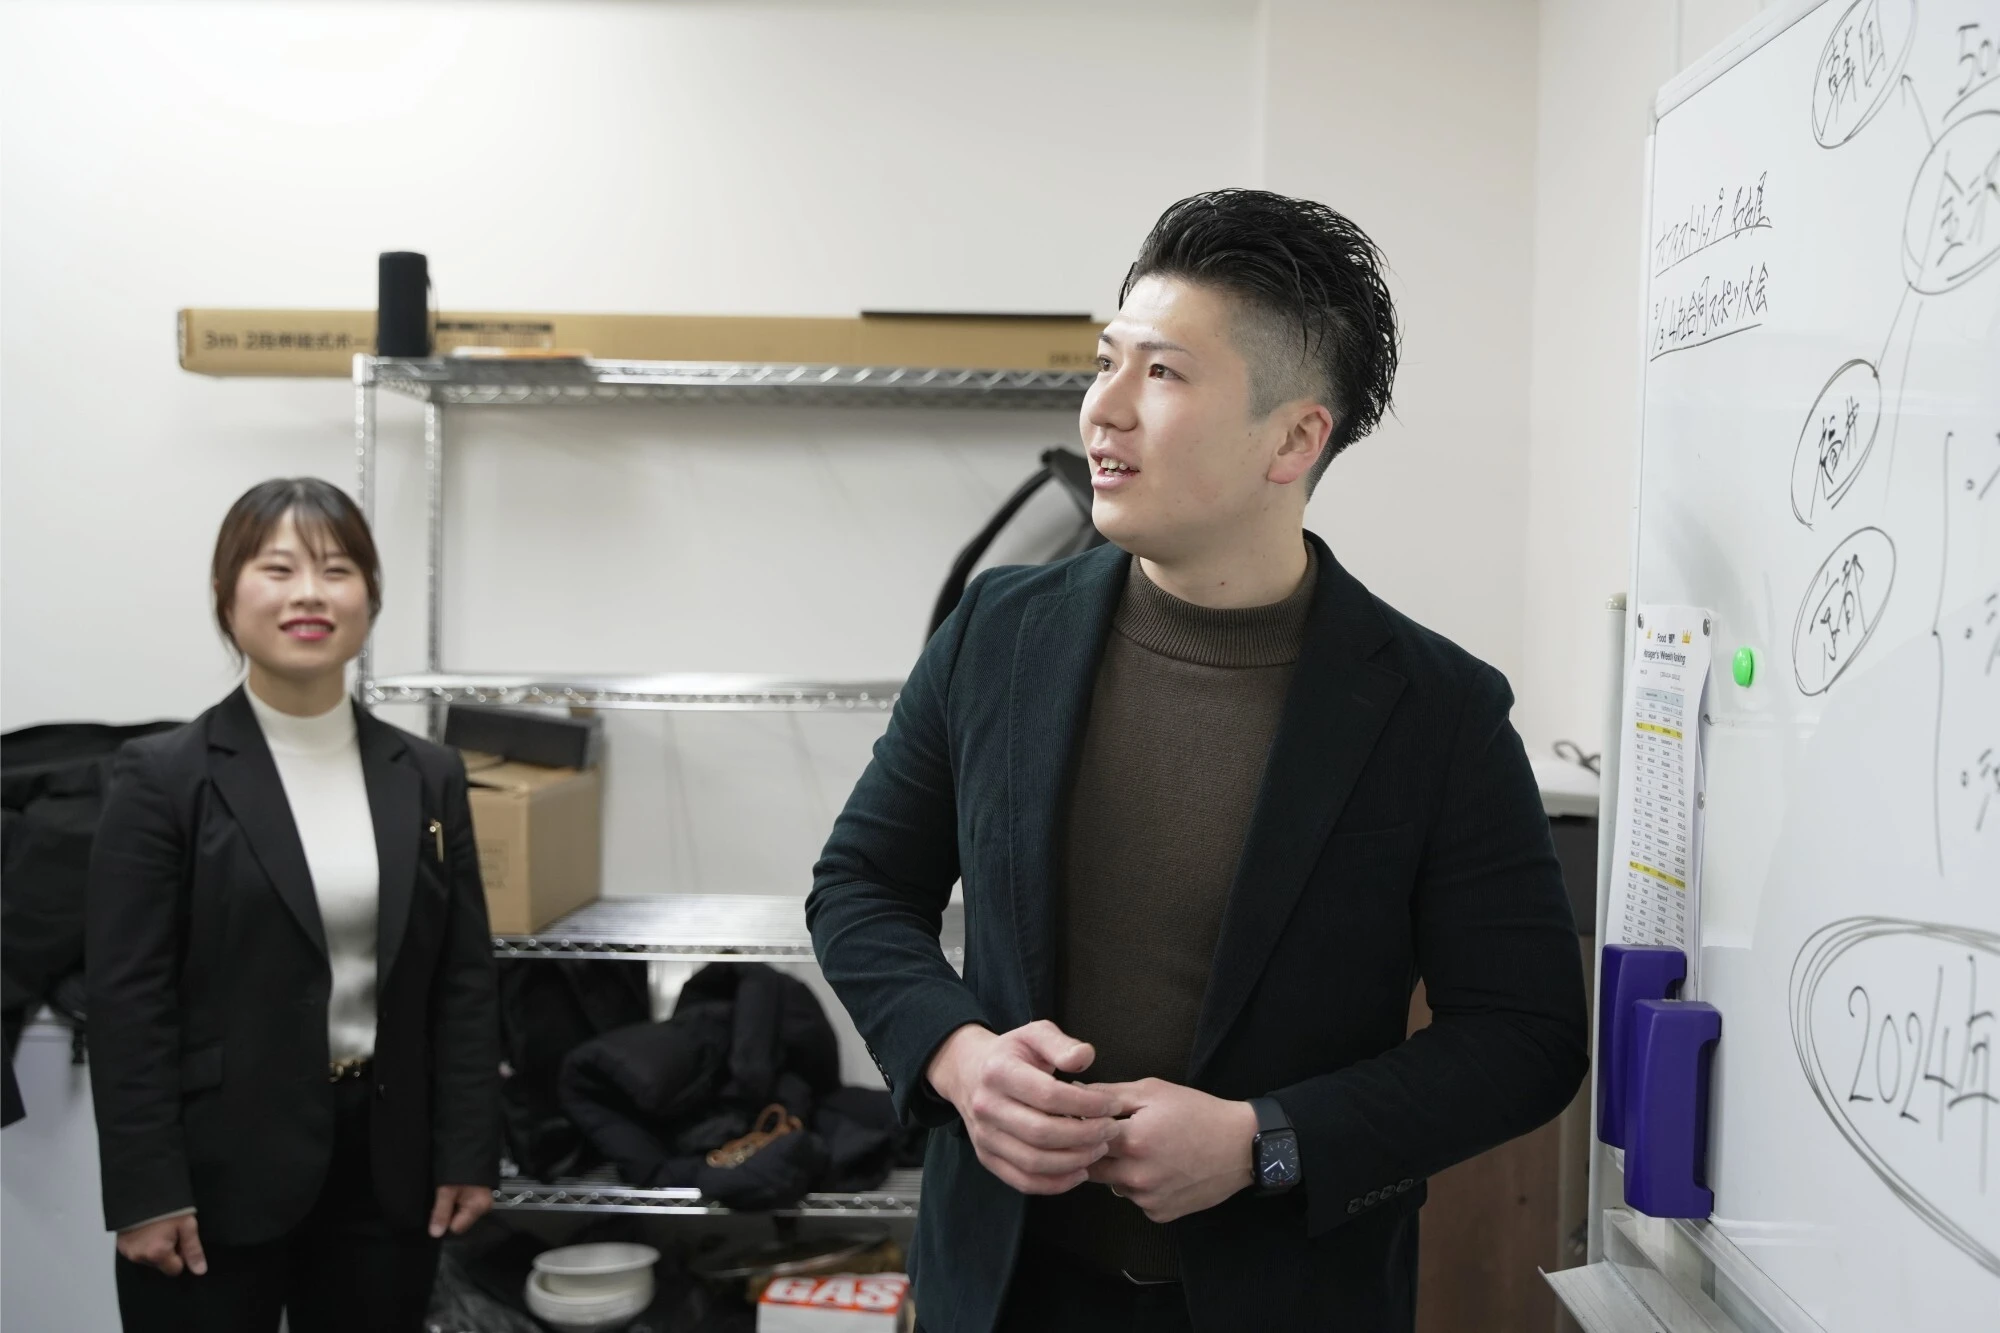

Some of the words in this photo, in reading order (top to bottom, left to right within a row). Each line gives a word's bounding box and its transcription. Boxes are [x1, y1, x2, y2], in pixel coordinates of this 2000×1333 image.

[1957, 22, 2000, 97] 50
[1848, 955, 2000, 1195] 2024年
[764, 1275, 906, 1310] GAS
